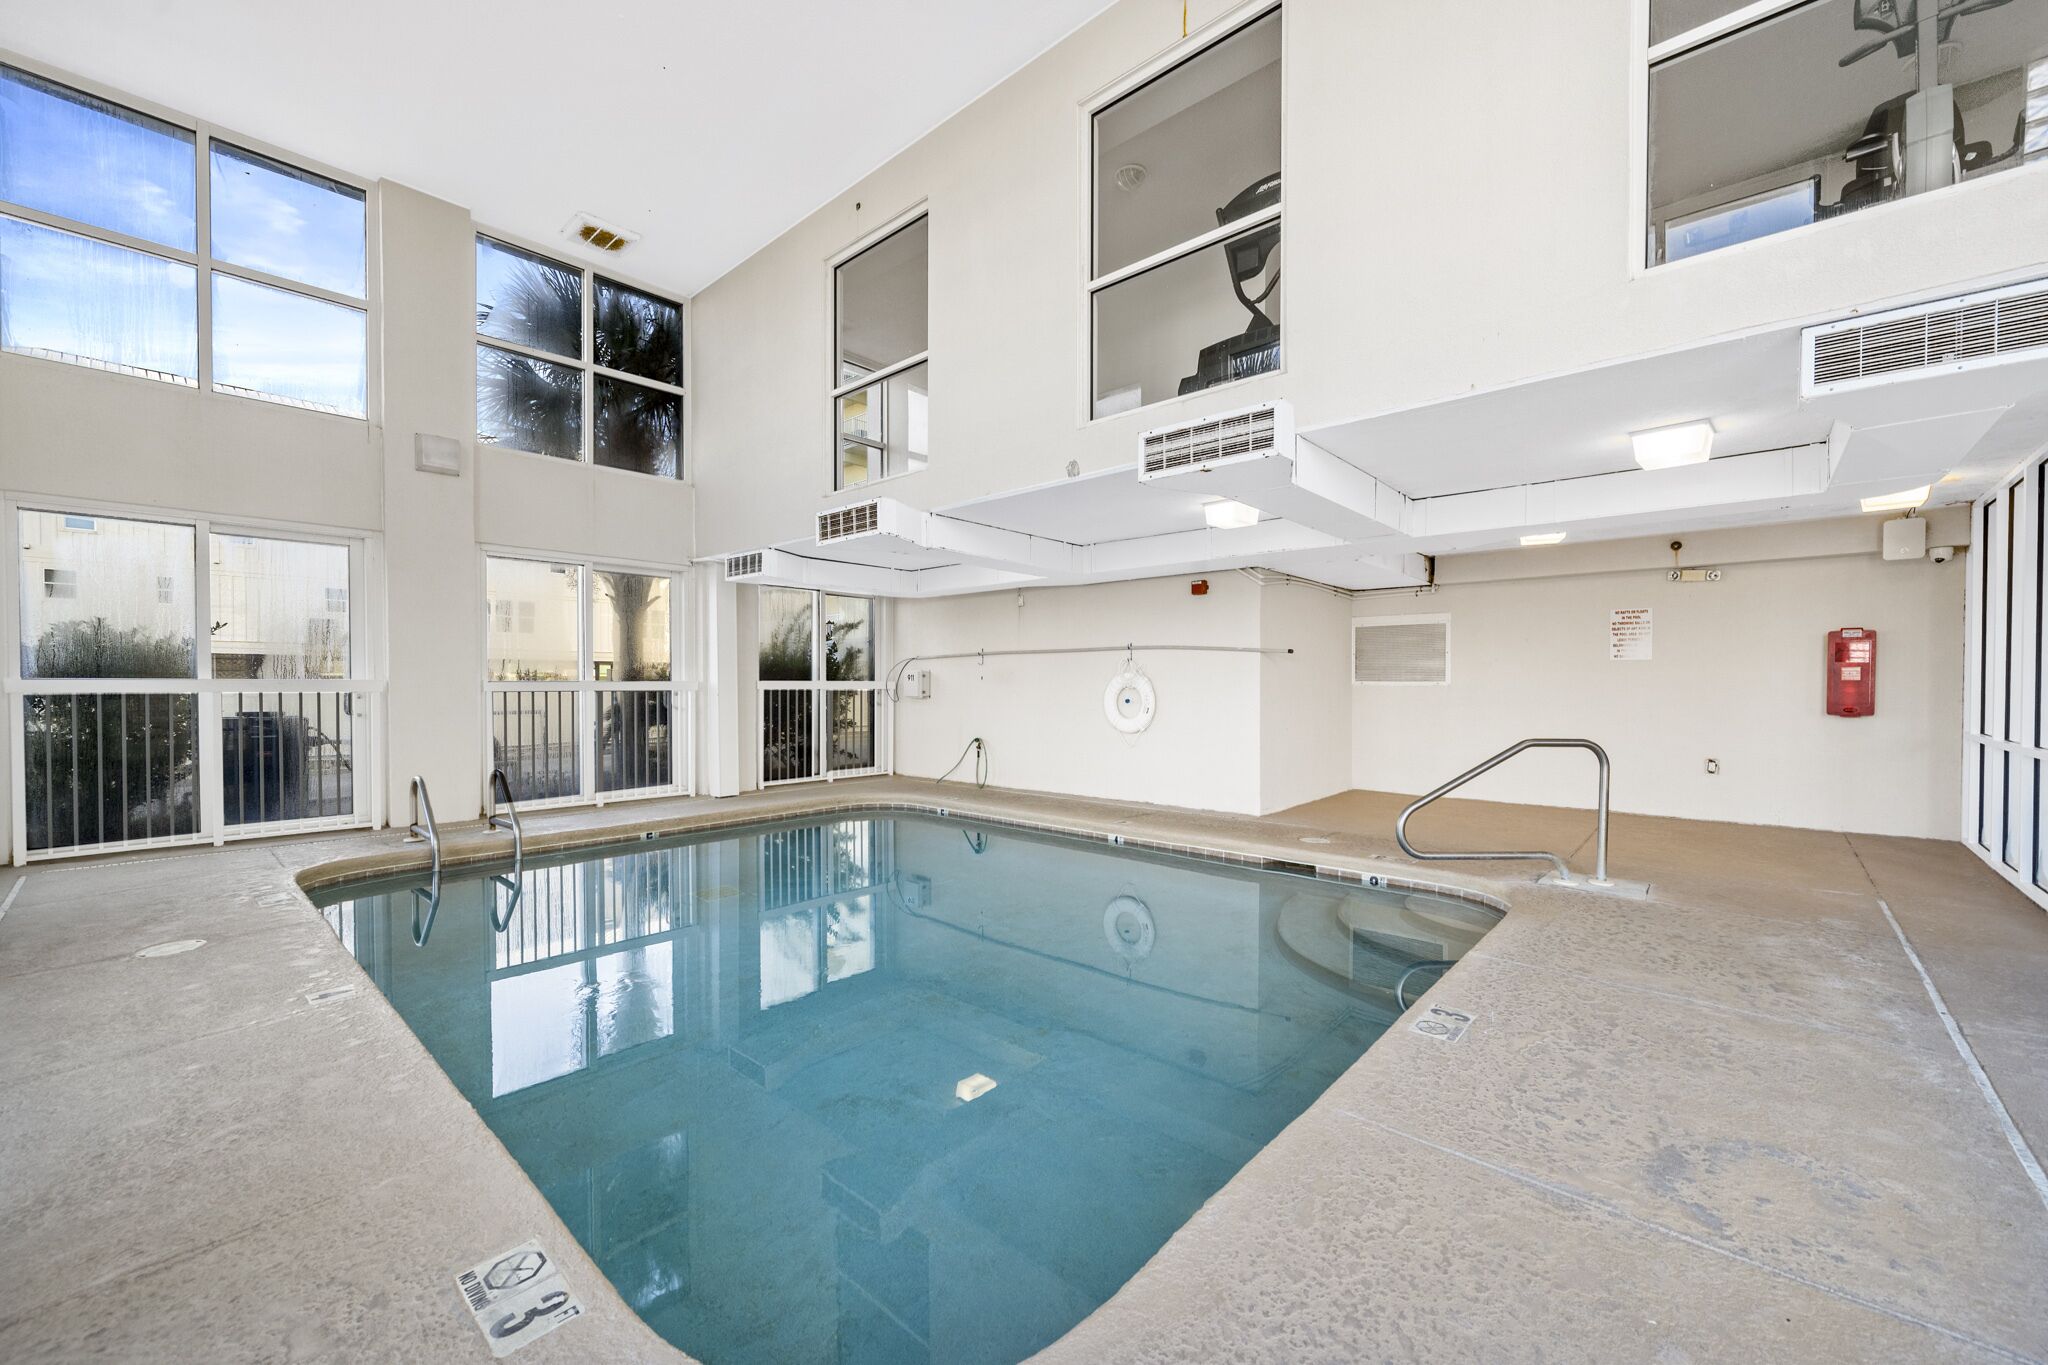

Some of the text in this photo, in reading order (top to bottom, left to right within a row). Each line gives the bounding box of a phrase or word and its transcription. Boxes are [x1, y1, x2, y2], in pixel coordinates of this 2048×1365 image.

[458, 1270, 491, 1312] NO DIVING
[489, 1290, 570, 1339] 3
